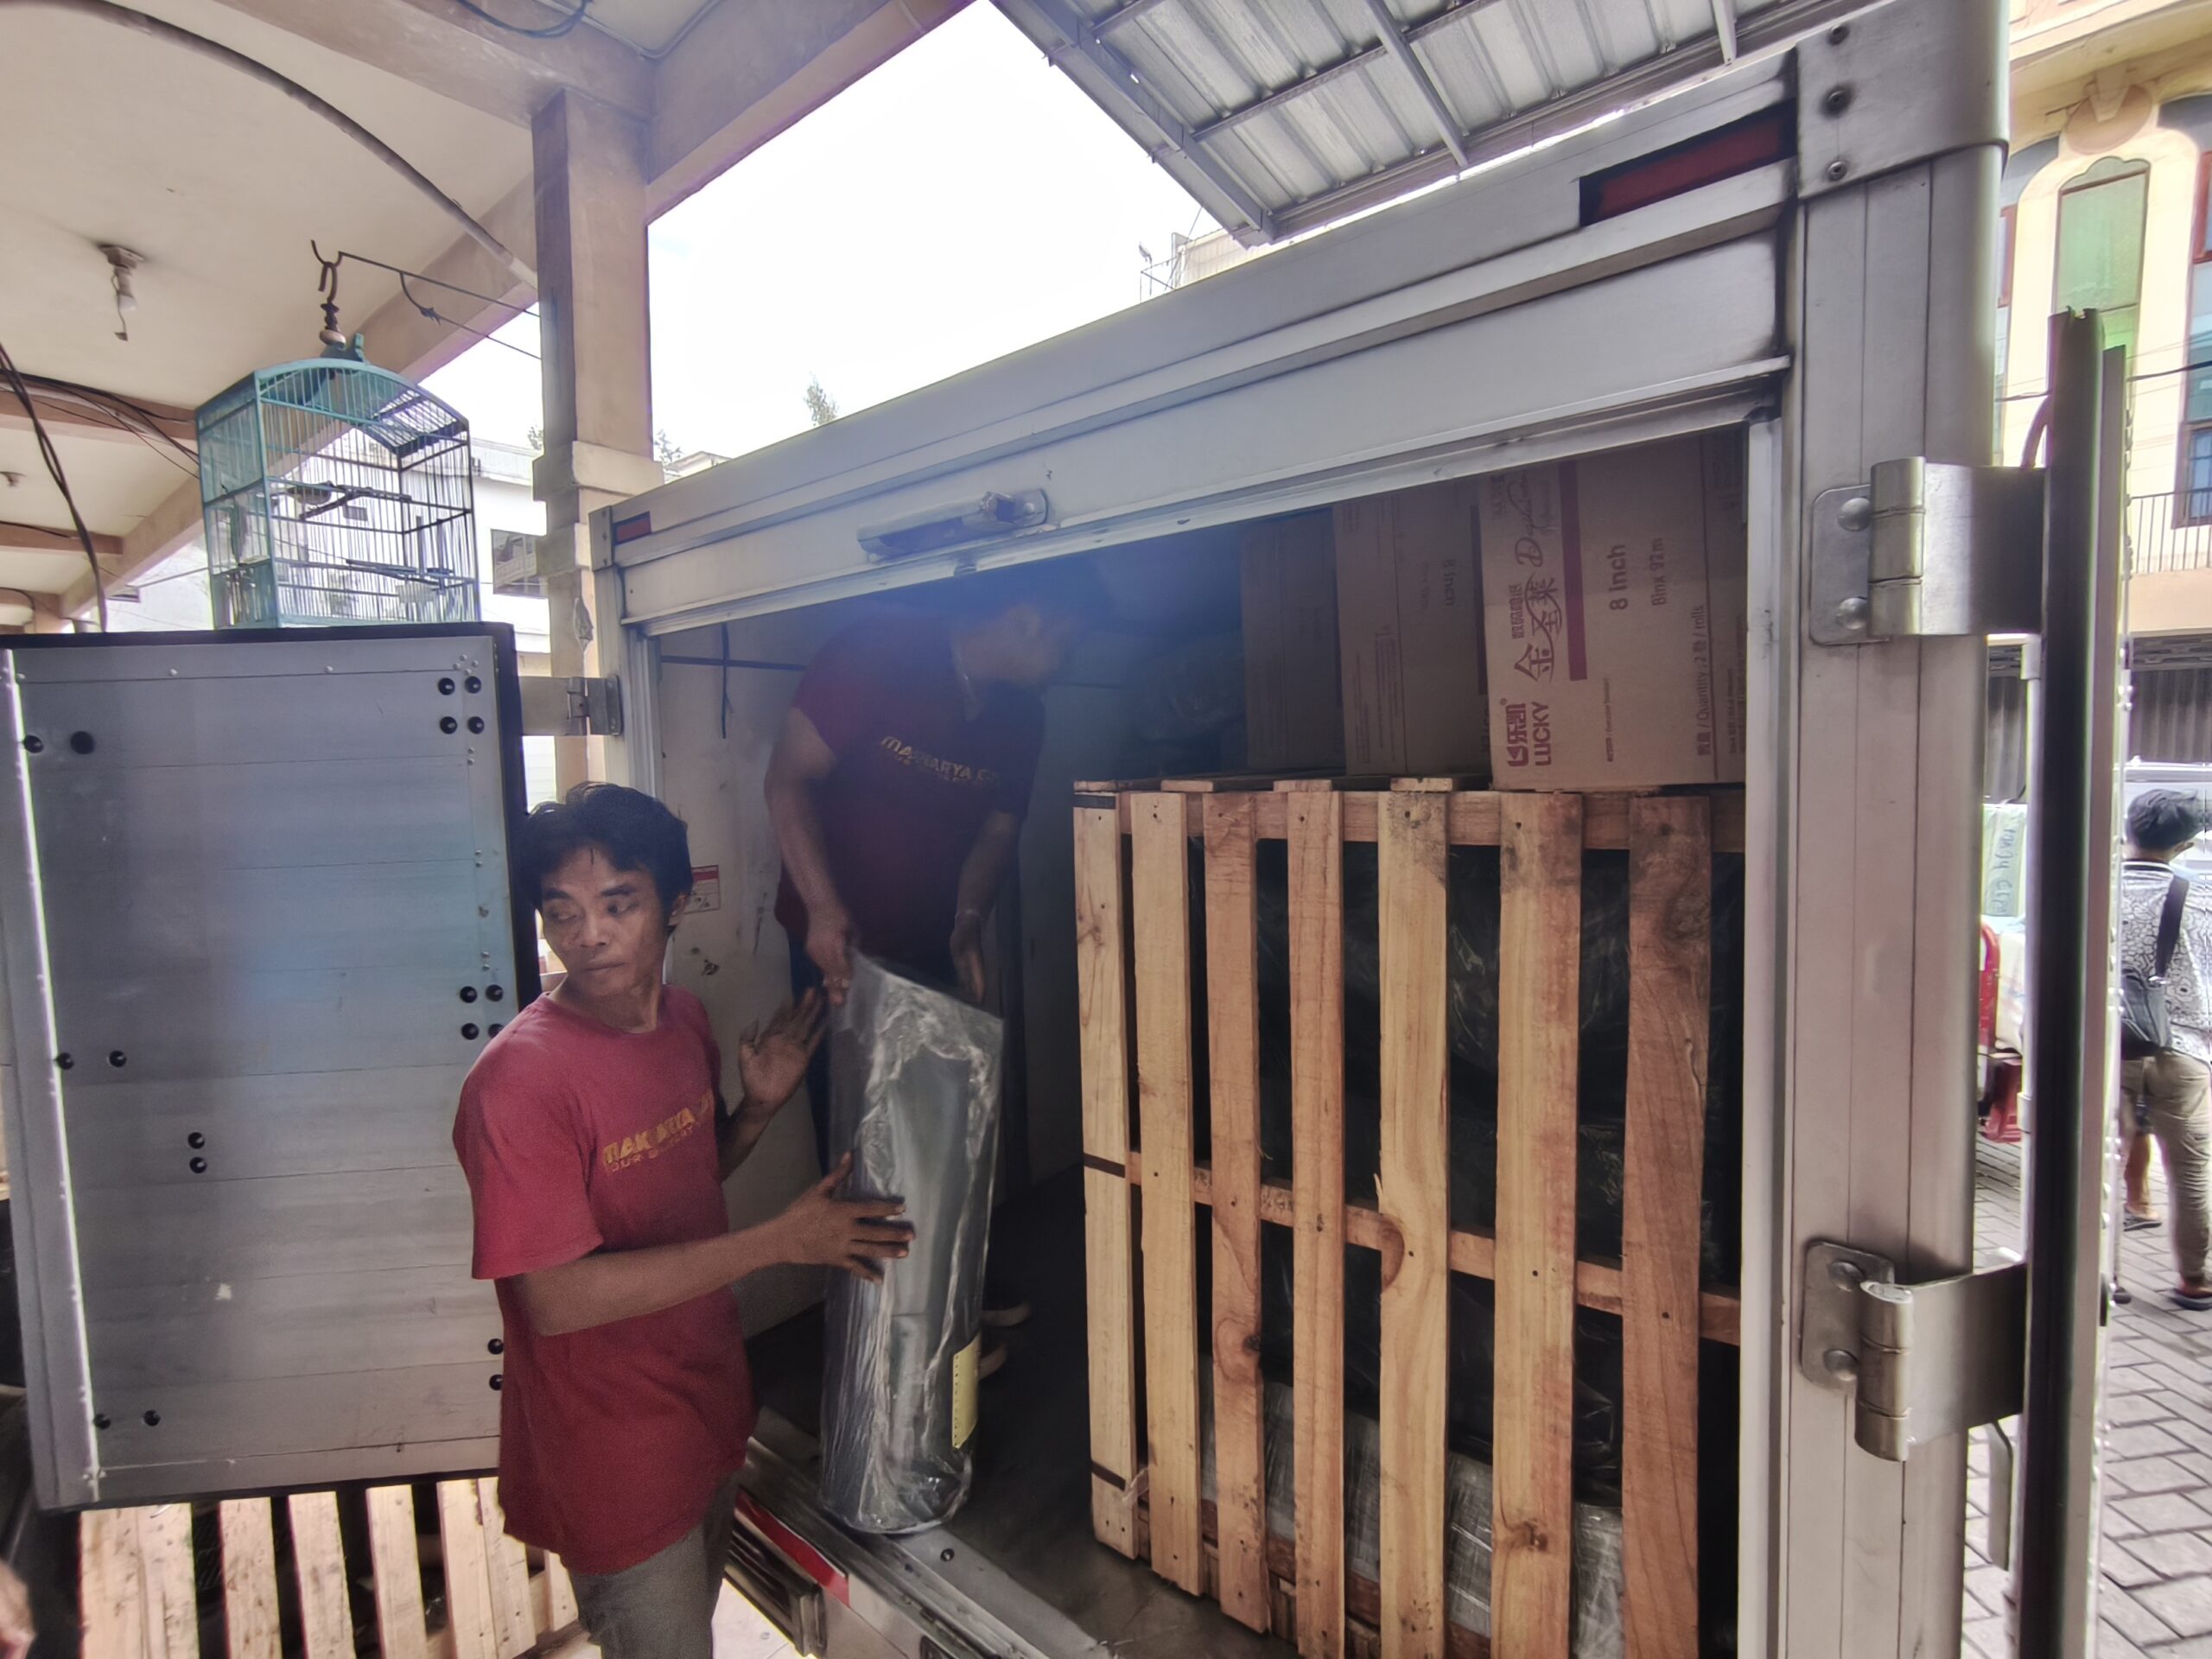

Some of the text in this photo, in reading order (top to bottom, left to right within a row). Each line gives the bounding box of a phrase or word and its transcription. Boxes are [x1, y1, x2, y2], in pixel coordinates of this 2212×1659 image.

[1606, 543, 1628, 611] 8 Inch
[1694, 672, 1711, 721] Quantity
[1532, 701, 1553, 766] LUCKY
